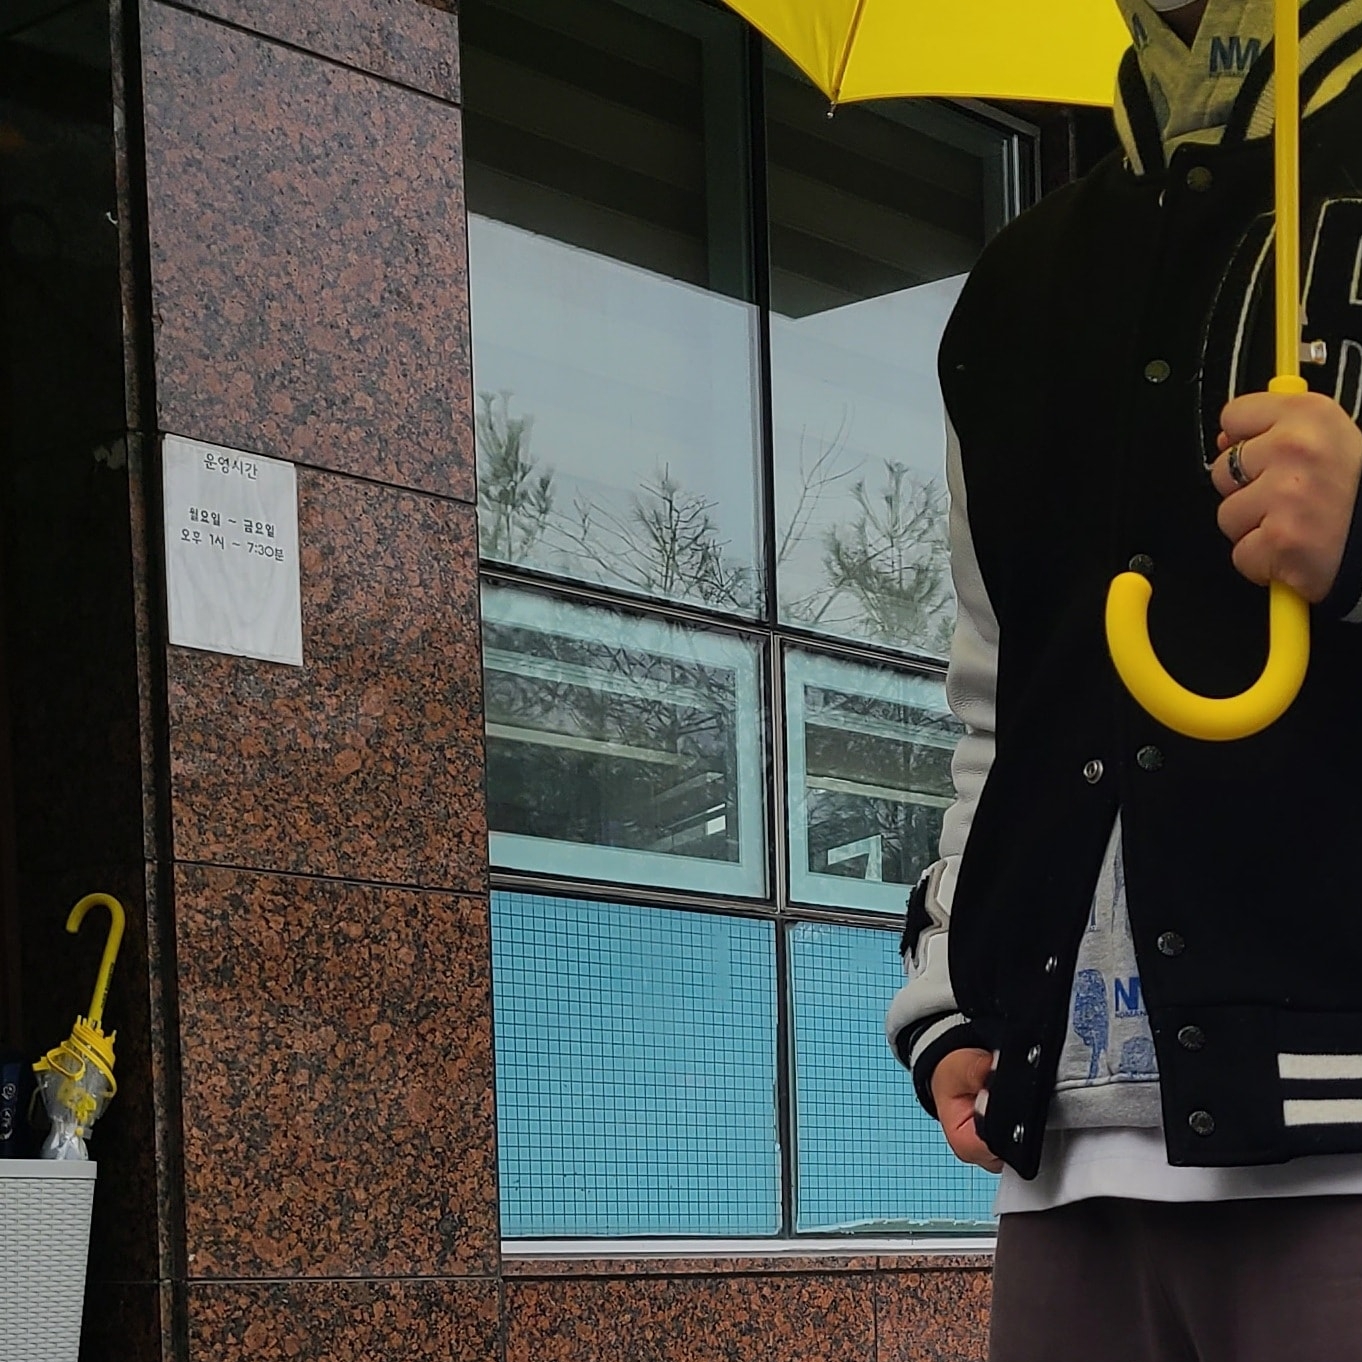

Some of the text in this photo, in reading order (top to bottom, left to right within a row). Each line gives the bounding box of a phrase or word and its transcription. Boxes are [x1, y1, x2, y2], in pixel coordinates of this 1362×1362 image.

[203, 453, 258, 480] 운영시간
[189, 507, 221, 527] 월요일
[243, 519, 275, 538] 금요일
[180, 528, 202, 545] 오후
[208, 533, 225, 550] 1시
[247, 542, 285, 562] 7:30분
